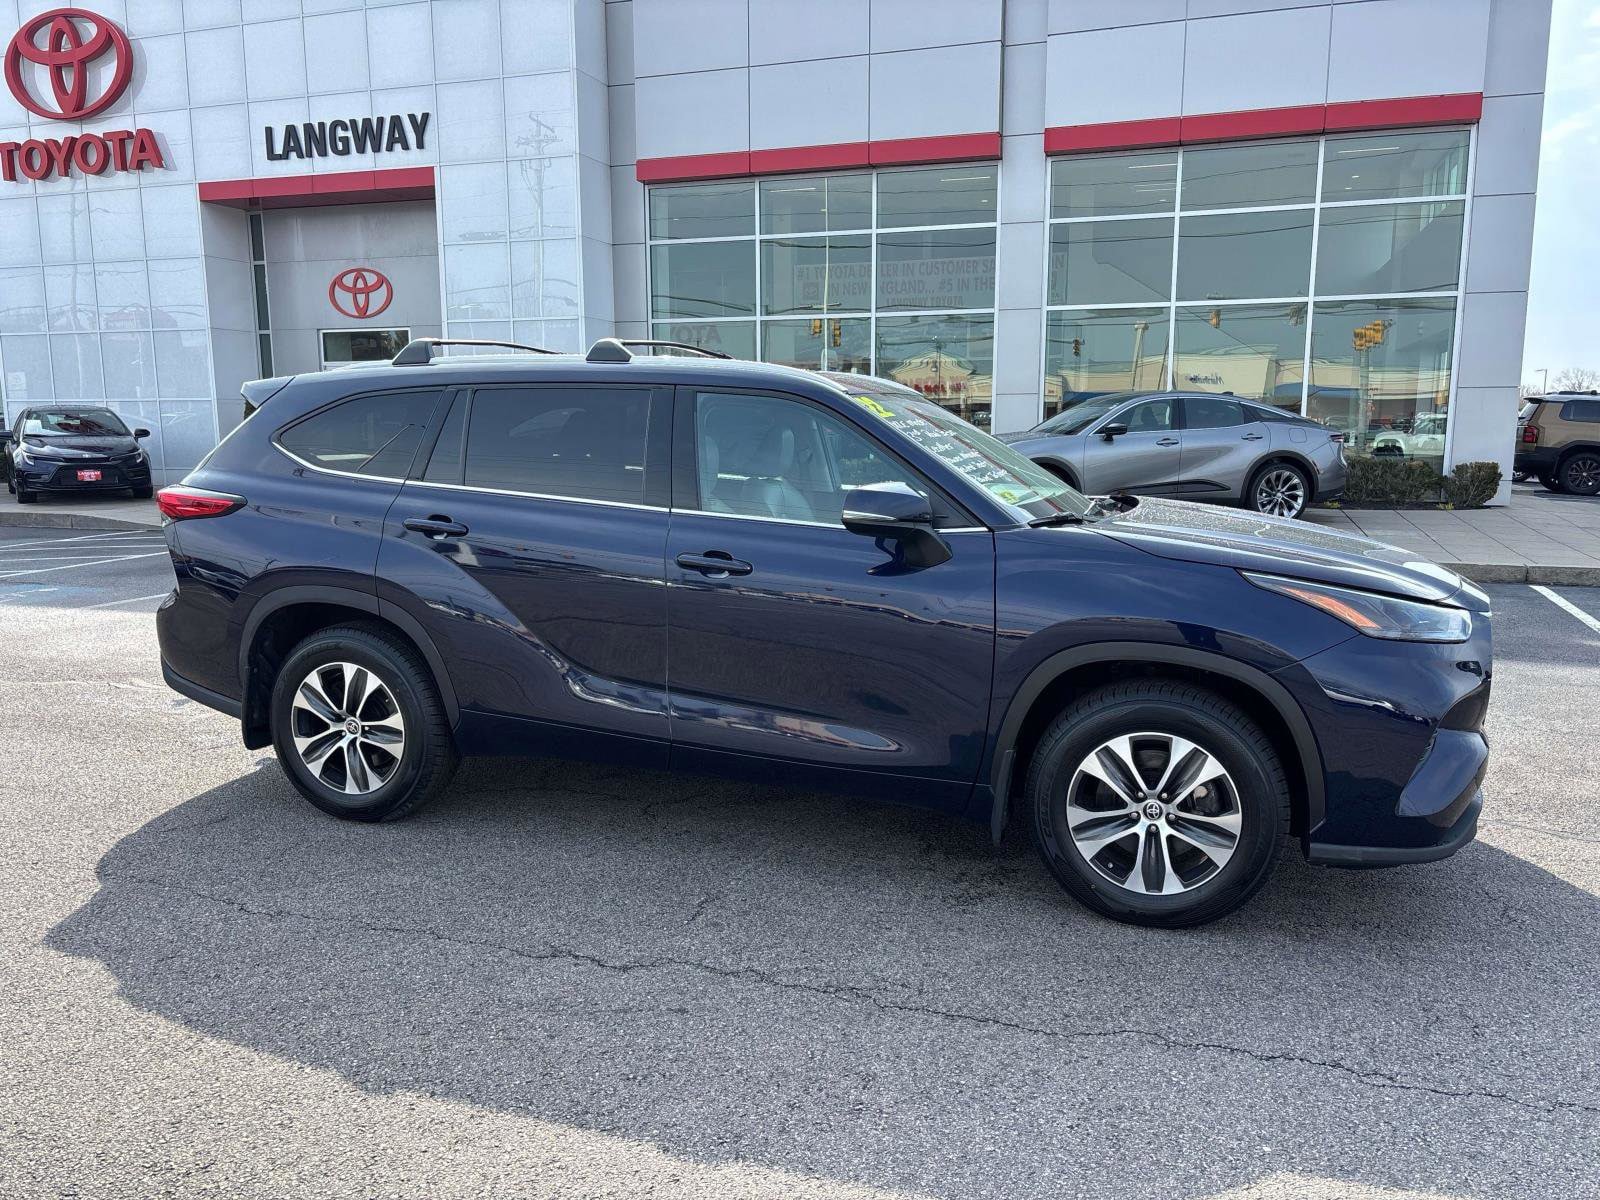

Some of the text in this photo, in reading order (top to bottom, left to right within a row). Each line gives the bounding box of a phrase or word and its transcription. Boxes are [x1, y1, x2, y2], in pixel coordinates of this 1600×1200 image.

[264, 112, 431, 161] LANGWAY
[0, 128, 164, 182] TOYOTA
[858, 262, 898, 278] DELER
[902, 262, 915, 277] IN
[918, 259, 978, 276] CUSTOMER
[957, 278, 970, 292] IN
